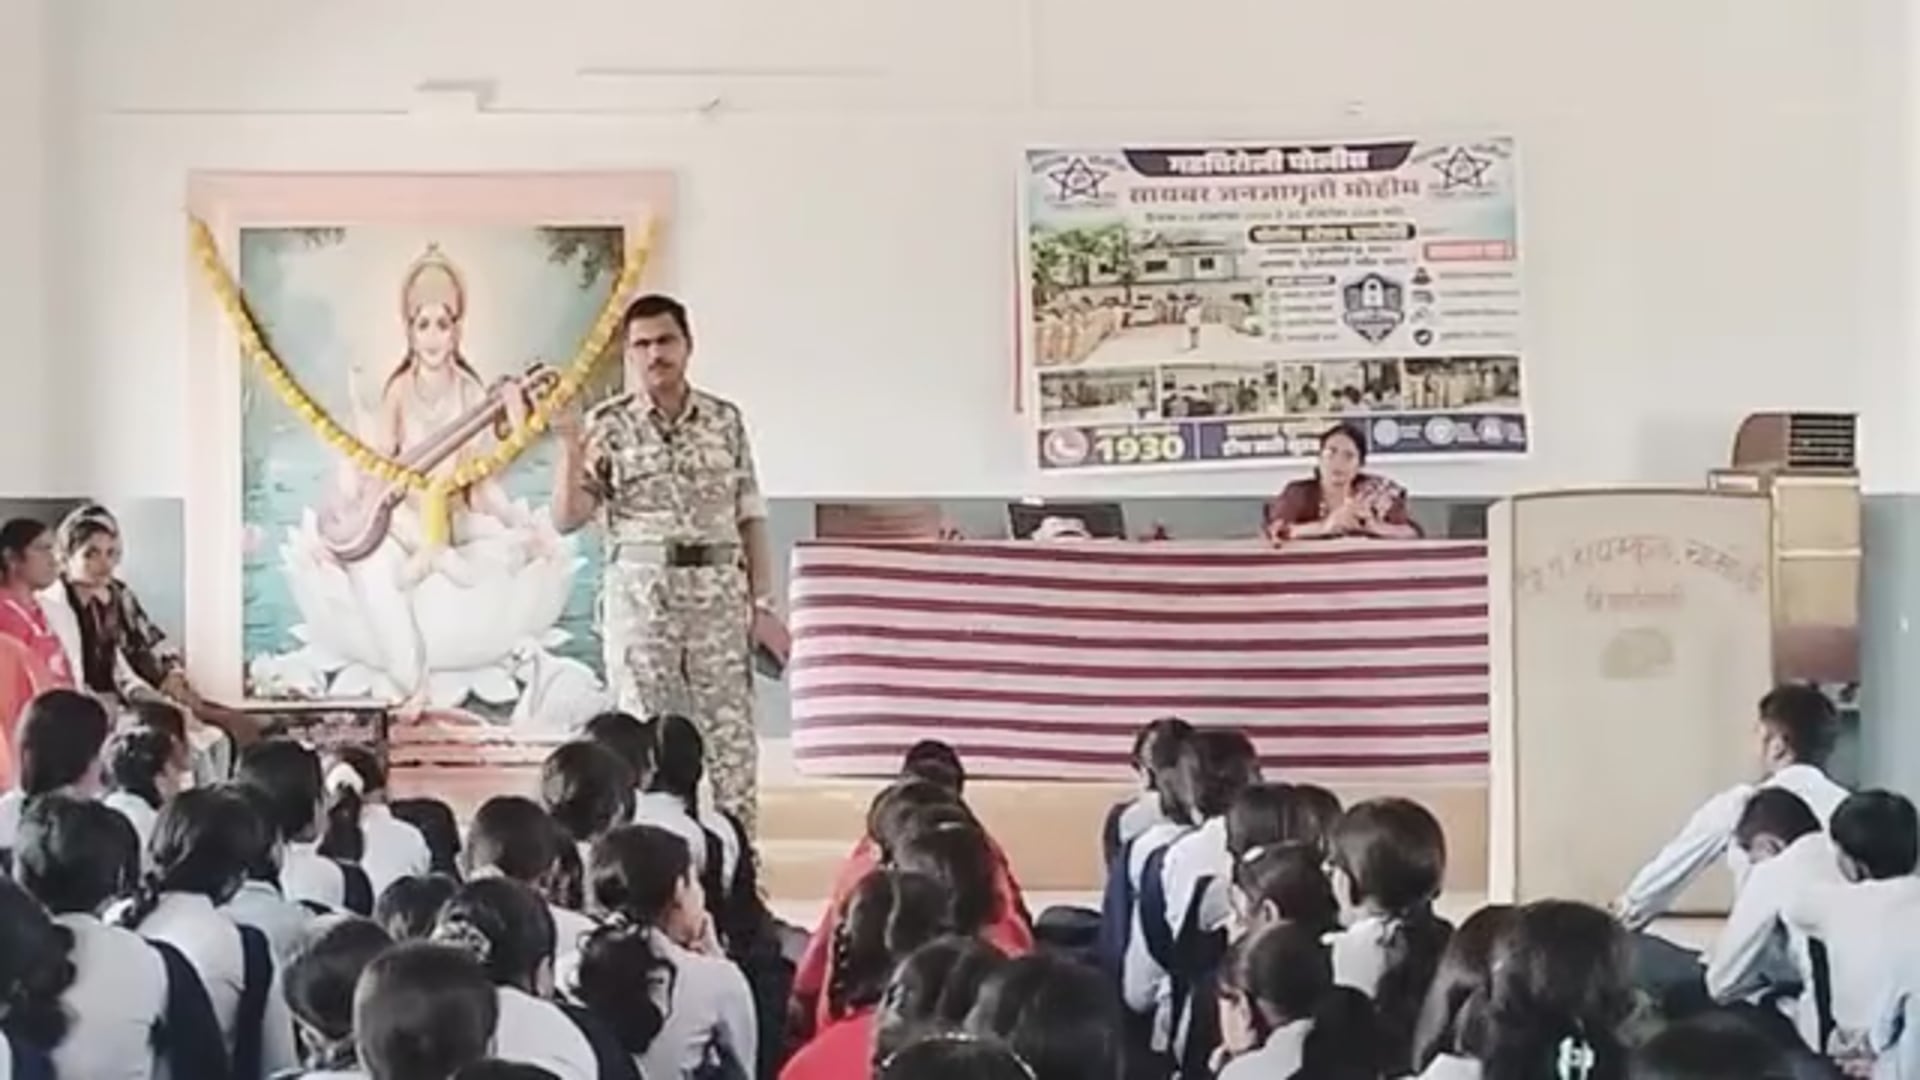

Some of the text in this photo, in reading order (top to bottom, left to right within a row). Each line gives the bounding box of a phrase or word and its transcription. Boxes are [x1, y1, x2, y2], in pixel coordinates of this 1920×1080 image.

[1288, 146, 1369, 170] पोलीस
[1130, 186, 1210, 204] सायबर
[1220, 179, 1336, 205] जनजागृती
[1344, 176, 1420, 199] मोहीम
[1095, 433, 1185, 463] 1930
